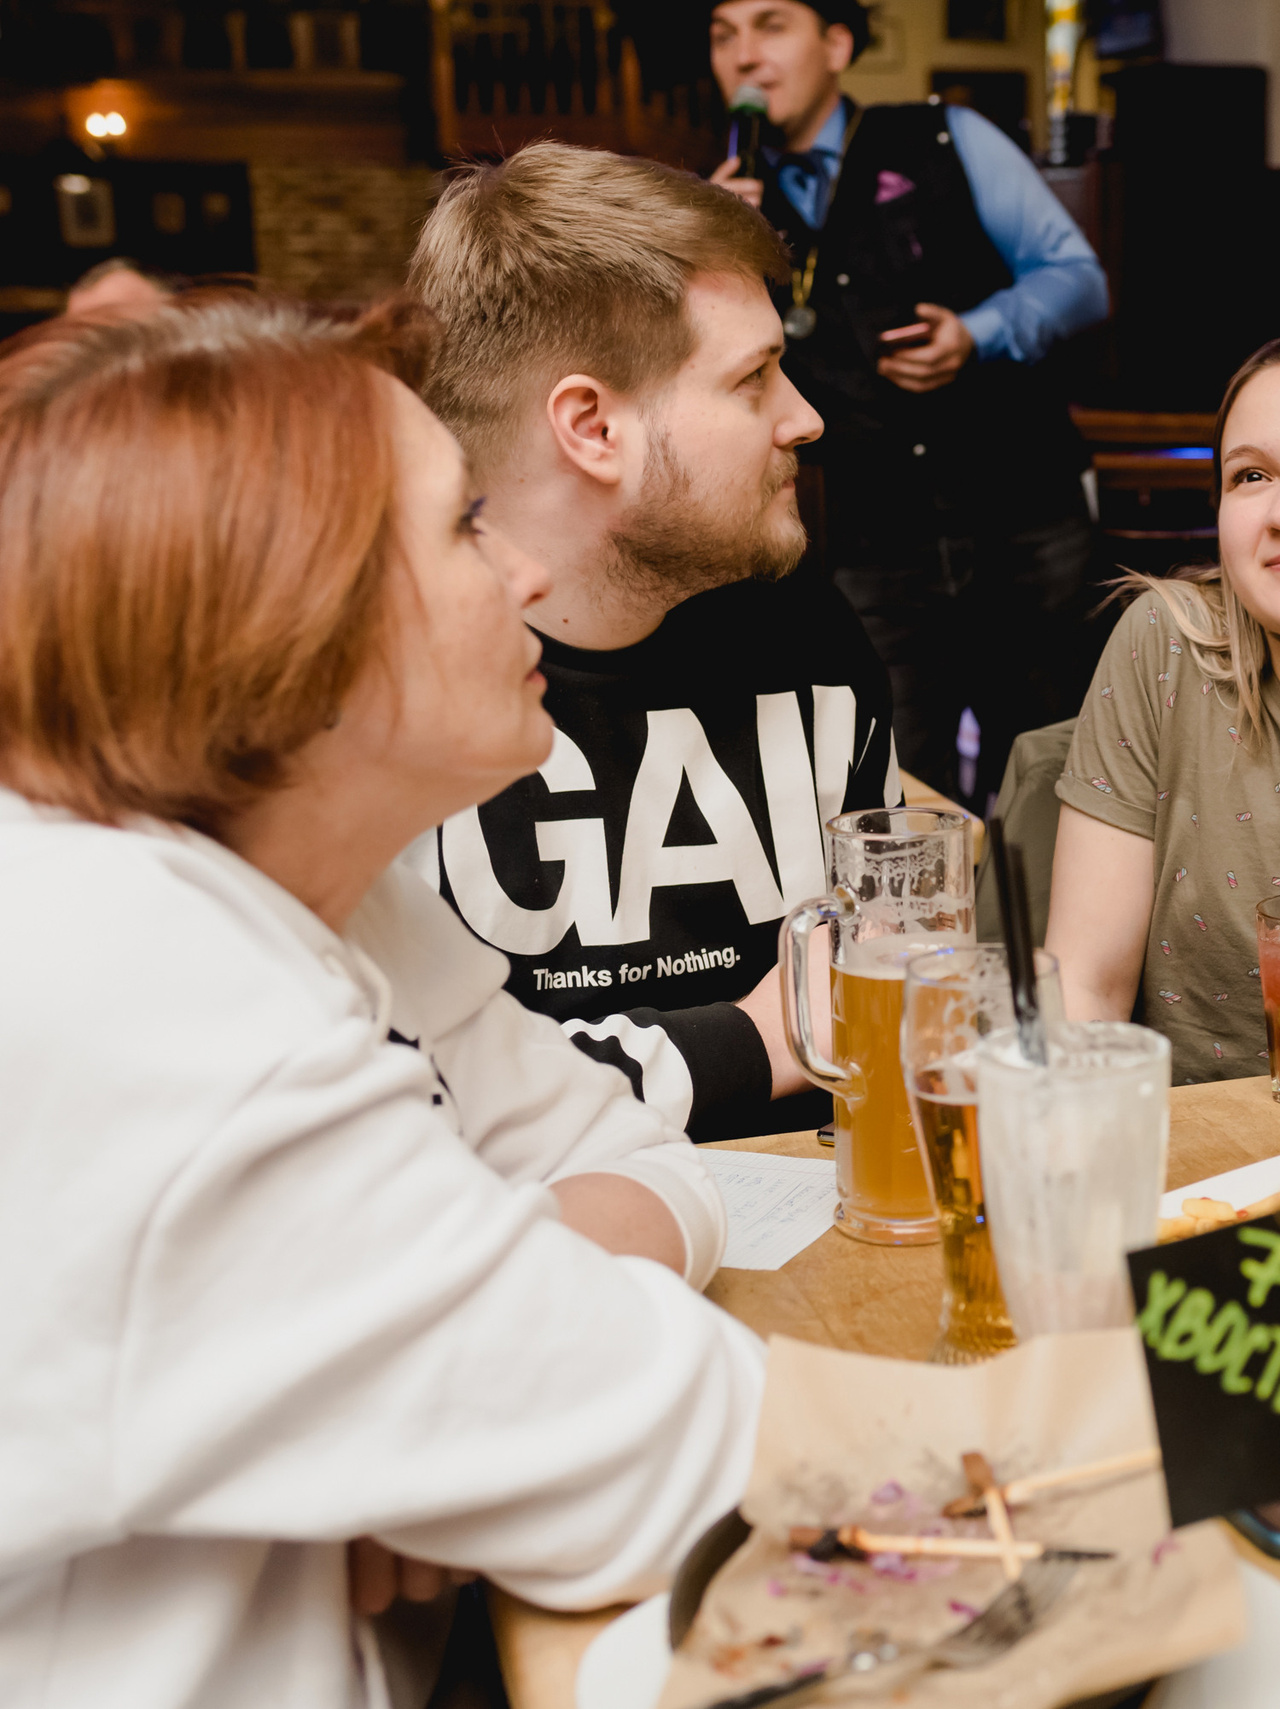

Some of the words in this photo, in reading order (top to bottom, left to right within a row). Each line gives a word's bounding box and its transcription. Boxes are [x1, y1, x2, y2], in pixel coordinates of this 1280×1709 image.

[533, 966, 613, 991] Thanks
[619, 963, 652, 984] for
[656, 946, 741, 978] Nothing.
